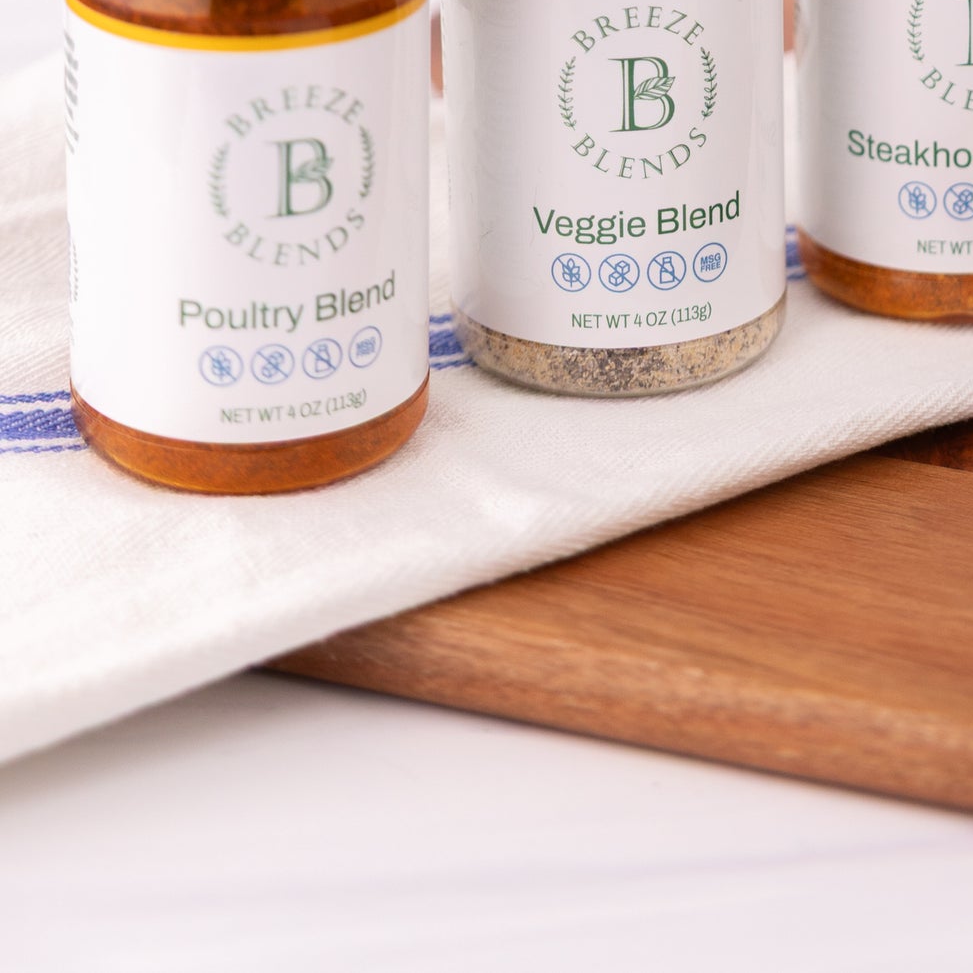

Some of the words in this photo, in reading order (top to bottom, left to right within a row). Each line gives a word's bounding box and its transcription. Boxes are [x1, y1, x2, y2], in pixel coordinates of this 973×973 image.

[571, 6, 704, 52] BREEZE
[227, 85, 364, 138] BREEZE
[608, 56, 676, 132] B
[270, 137, 334, 218] B
[571, 127, 707, 180] BLENDS
[223, 208, 365, 267] BLENDS
[533, 206, 646, 245] Veggie
[657, 190, 740, 235] Blend
[700, 252, 721, 265] MSG
[700, 261, 721, 273] FREE
[916, 239, 946, 255] NET
[950, 240, 973, 255] WT
[179, 299, 304, 333] Poultry
[315, 270, 396, 323] Blend
[571, 313, 602, 329] NET
[606, 313, 631, 329] WT
[633, 313, 642, 328] 4
[645, 310, 668, 327] OZ
[671, 301, 713, 326] (113g)
[220, 408, 252, 424] NET
[258, 406, 283, 422] WT
[287, 405, 296, 418] 4
[300, 401, 321, 418] OZ
[326, 388, 367, 415] (113g)
